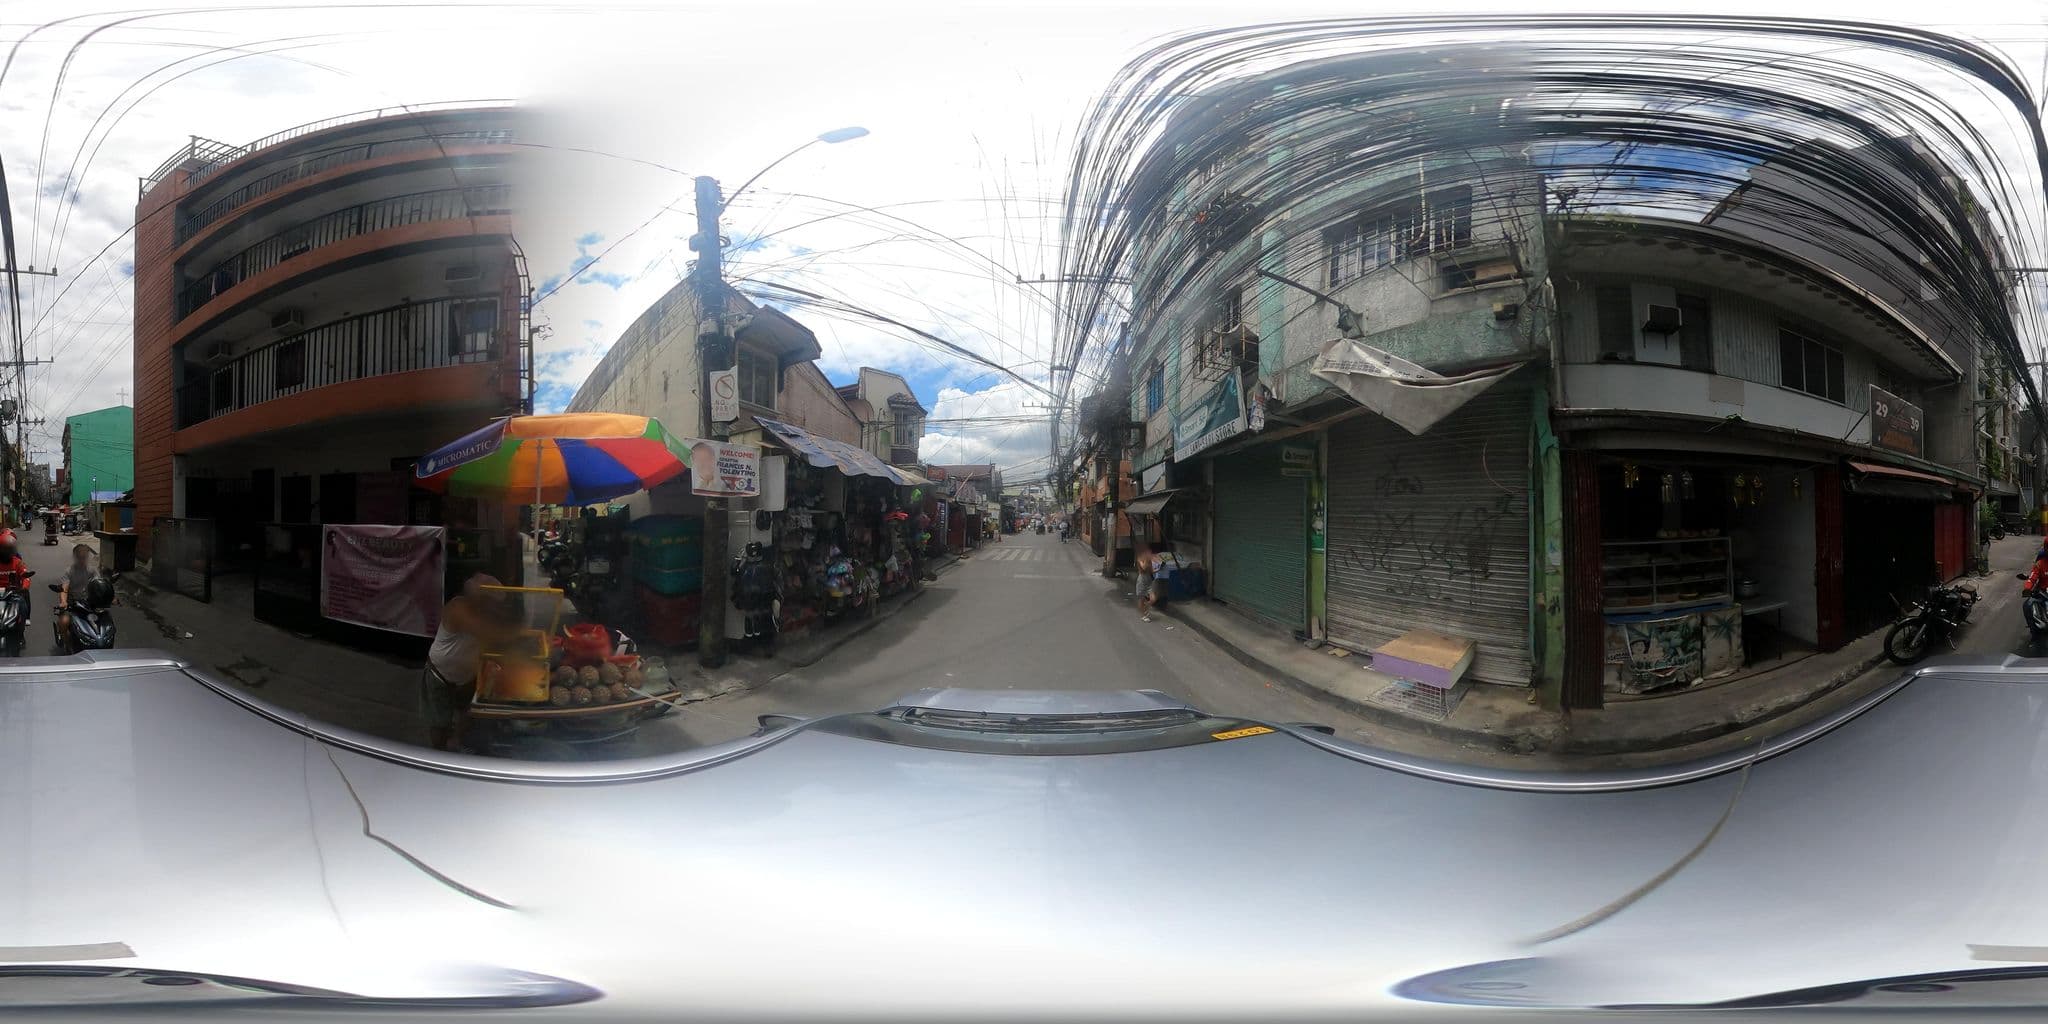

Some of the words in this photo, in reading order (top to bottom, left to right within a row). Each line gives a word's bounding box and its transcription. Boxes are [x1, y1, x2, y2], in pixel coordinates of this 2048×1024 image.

[1876, 401, 1888, 417] 29
[1216, 422, 1237, 442] STORE
[438, 441, 491, 465] MICROMATIC
[717, 461, 745, 470] FRANCIS
[720, 467, 756, 477] TOLENTINO
